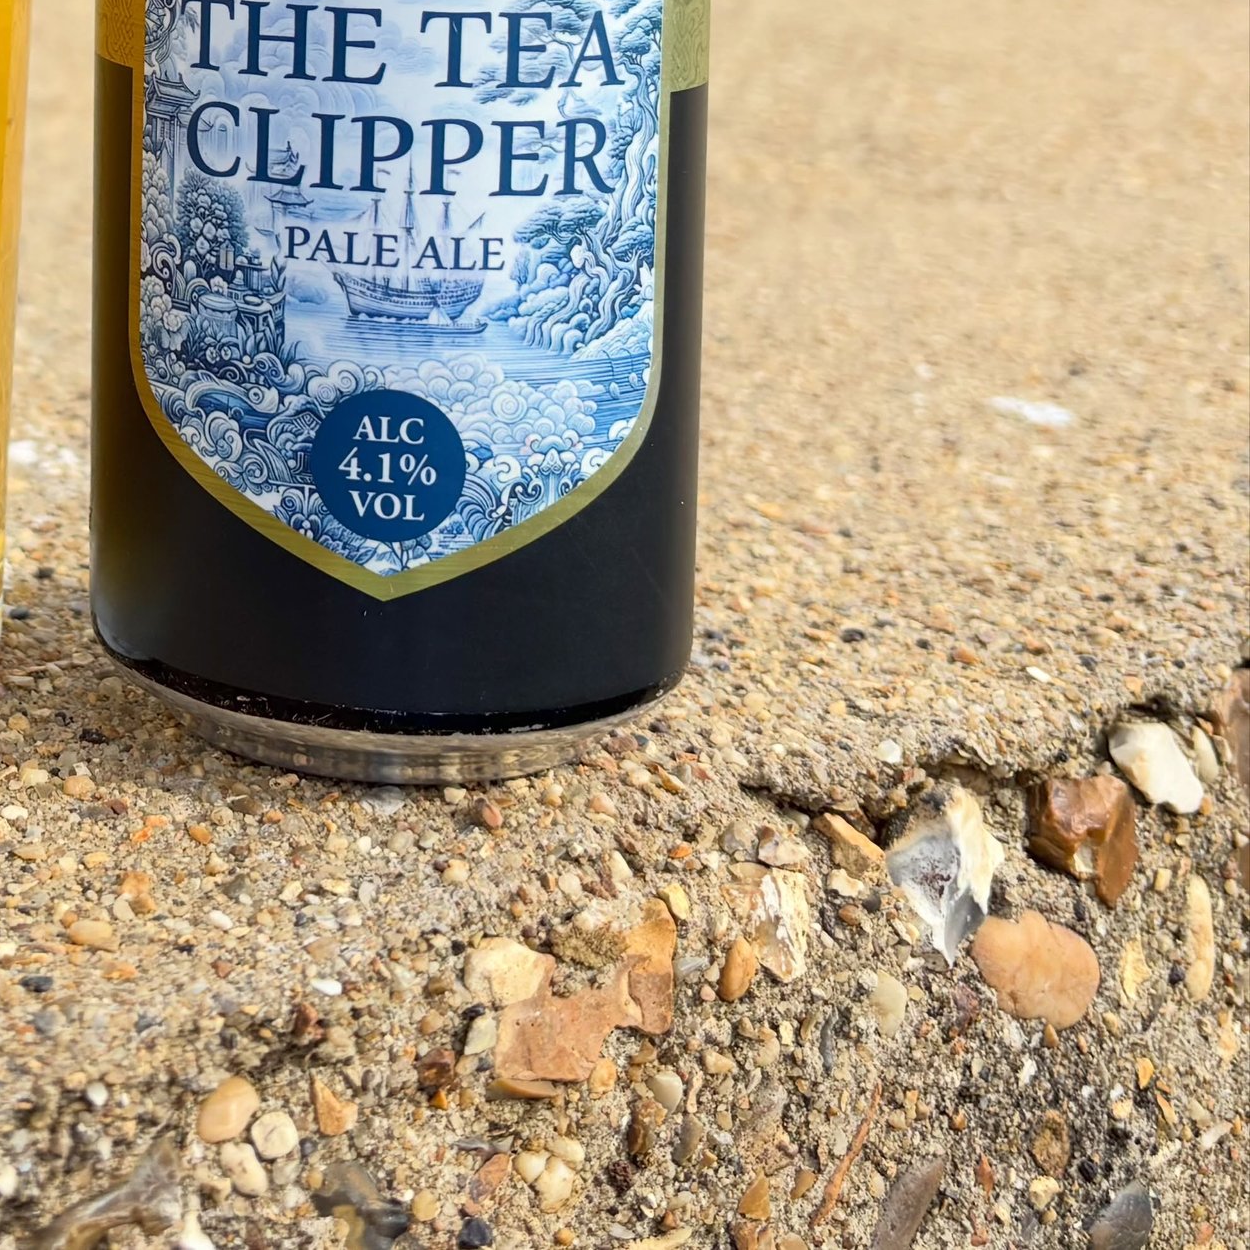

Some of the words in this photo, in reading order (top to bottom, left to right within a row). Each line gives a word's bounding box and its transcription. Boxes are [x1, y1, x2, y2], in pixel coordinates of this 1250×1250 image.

[420, 10, 625, 89] TEA
[187, 101, 615, 197] CLIPPER
[284, 226, 399, 269] PALE
[411, 235, 505, 271] ALE
[353, 415, 425, 445] ALC
[338, 447, 437, 486] 4.1%
[348, 490, 425, 522] VOL
